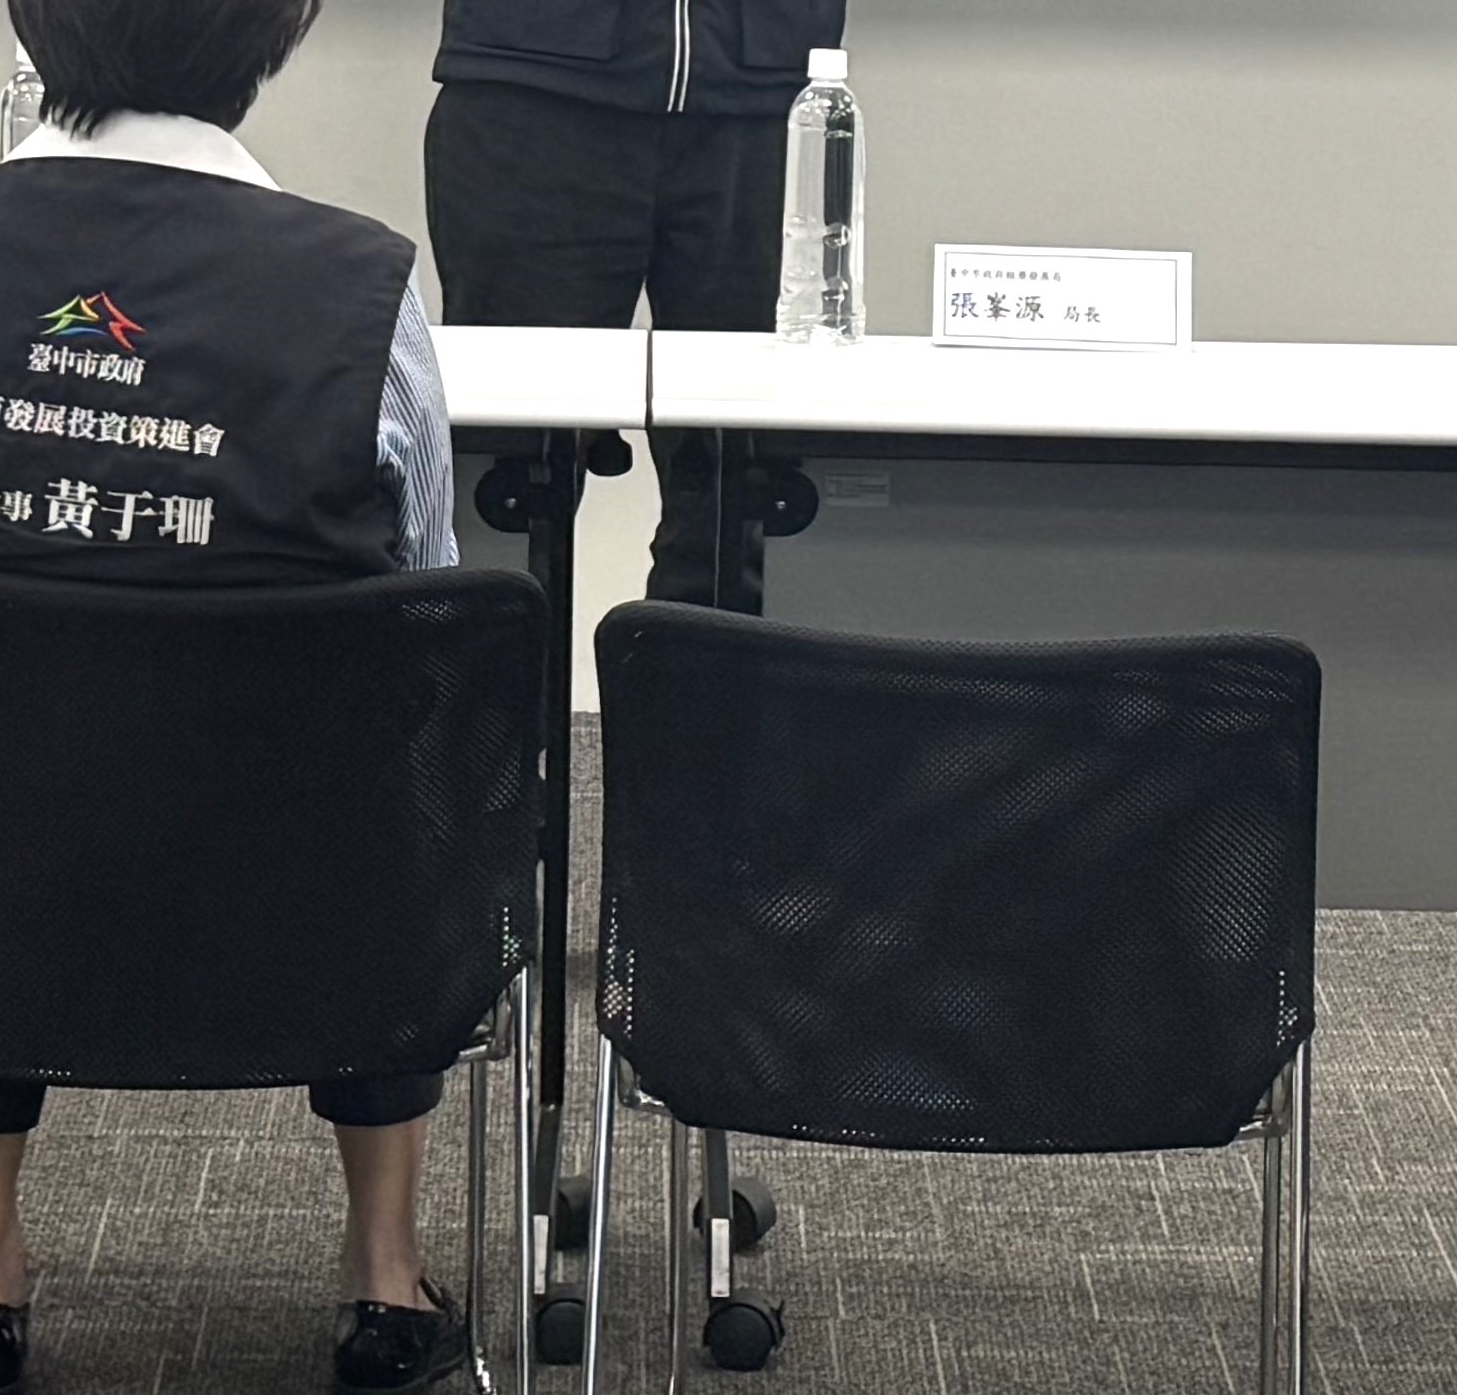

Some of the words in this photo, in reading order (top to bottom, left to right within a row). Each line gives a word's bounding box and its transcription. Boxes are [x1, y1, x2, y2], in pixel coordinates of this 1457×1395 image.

[27, 343, 147, 386] 臺中市政府
[42, 478, 215, 545] 黃于珊
